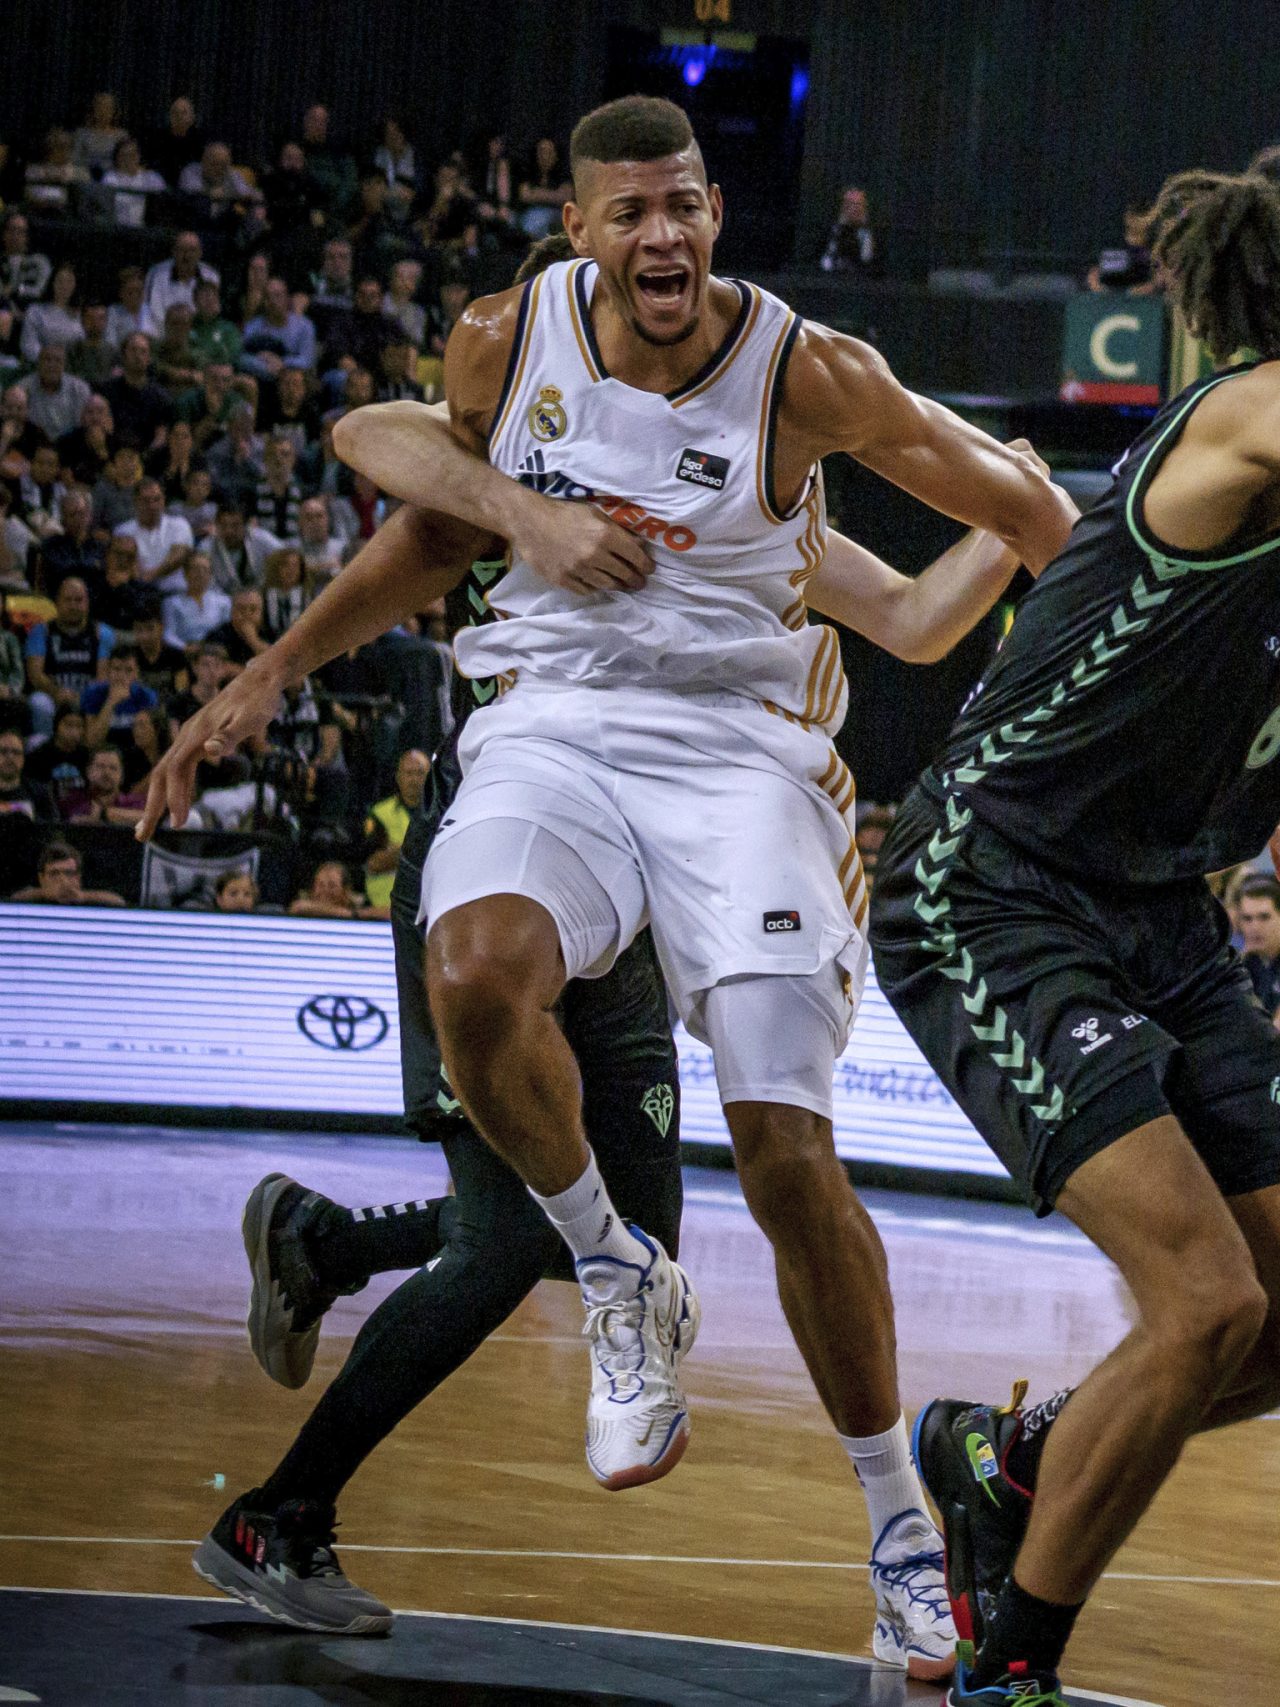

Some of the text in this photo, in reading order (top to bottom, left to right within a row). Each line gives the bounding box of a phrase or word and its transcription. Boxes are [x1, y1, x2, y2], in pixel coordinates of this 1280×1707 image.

[1090, 314, 1141, 378] C
[682, 457, 704, 471] liga
[679, 468, 723, 487] endesa
[766, 918, 794, 931] acb
